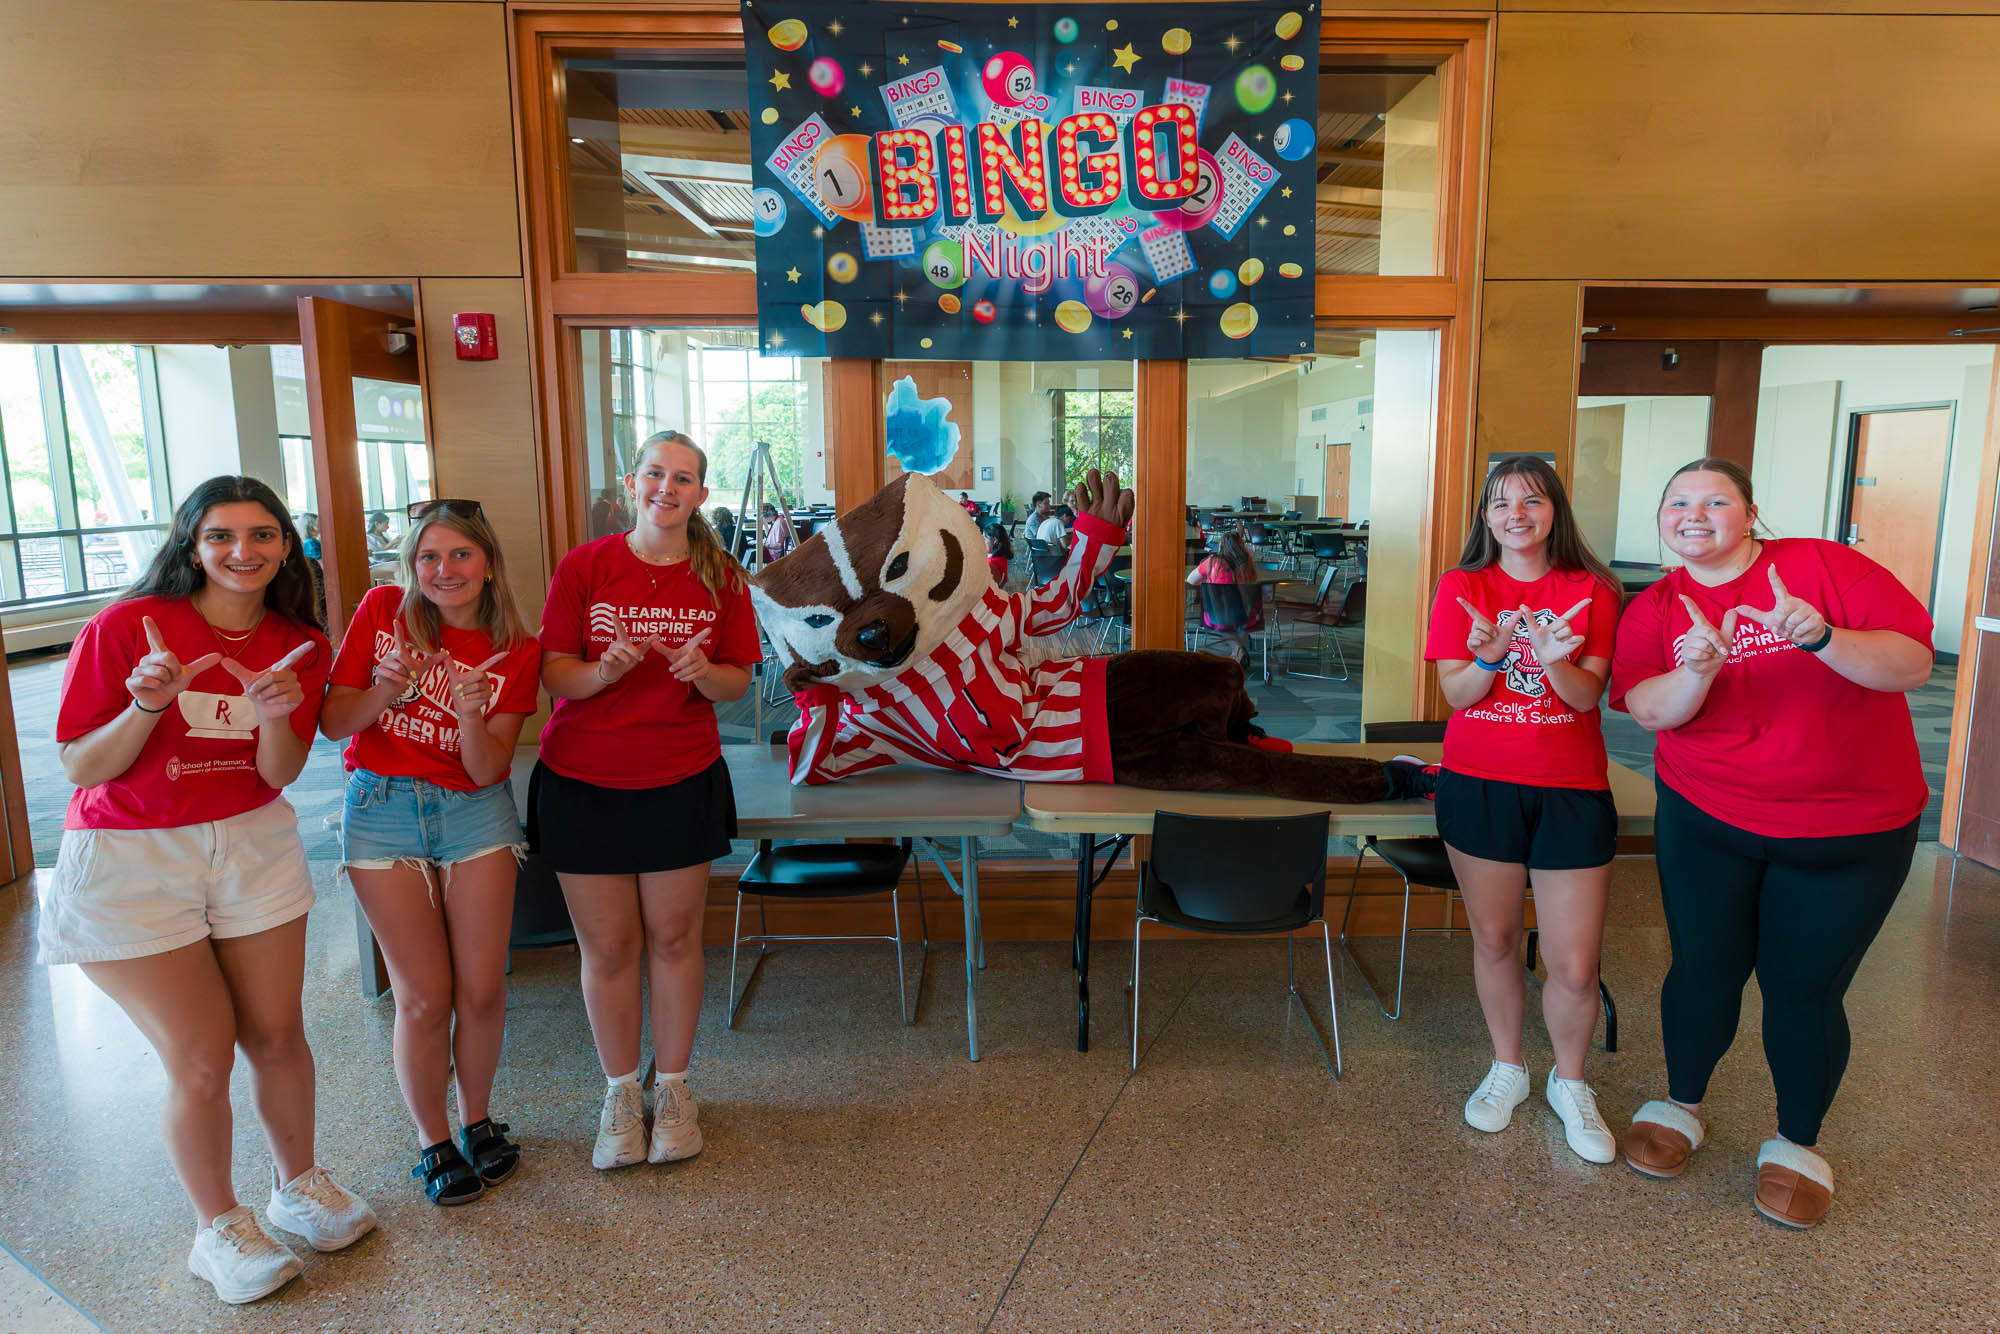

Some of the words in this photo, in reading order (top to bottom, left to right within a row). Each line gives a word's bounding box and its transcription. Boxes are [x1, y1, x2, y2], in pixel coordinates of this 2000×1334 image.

[887, 72, 940, 103] BINGO
[1015, 76, 1031, 92] 52
[1081, 90, 1136, 110] BINGO
[773, 122, 821, 171] BINGO
[868, 104, 1200, 228] BINGO
[1227, 140, 1272, 182] BINGO
[824, 169, 843, 197] 1
[1191, 174, 1212, 204] 2
[763, 198, 777, 213] 13
[962, 231, 1112, 294] Night
[931, 265, 949, 278] 48
[1112, 285, 1133, 304] 26
[619, 606, 676, 620] LEARN,
[679, 608, 716, 622] LEAD
[632, 622, 694, 634] INSPIRE
[1544, 698, 1552, 708] of
[418, 705, 444, 721] THE
[1464, 708, 1512, 723] Letters
[1515, 712, 1527, 723] &
[1530, 712, 1575, 724] Science
[182, 762, 203, 770] School
